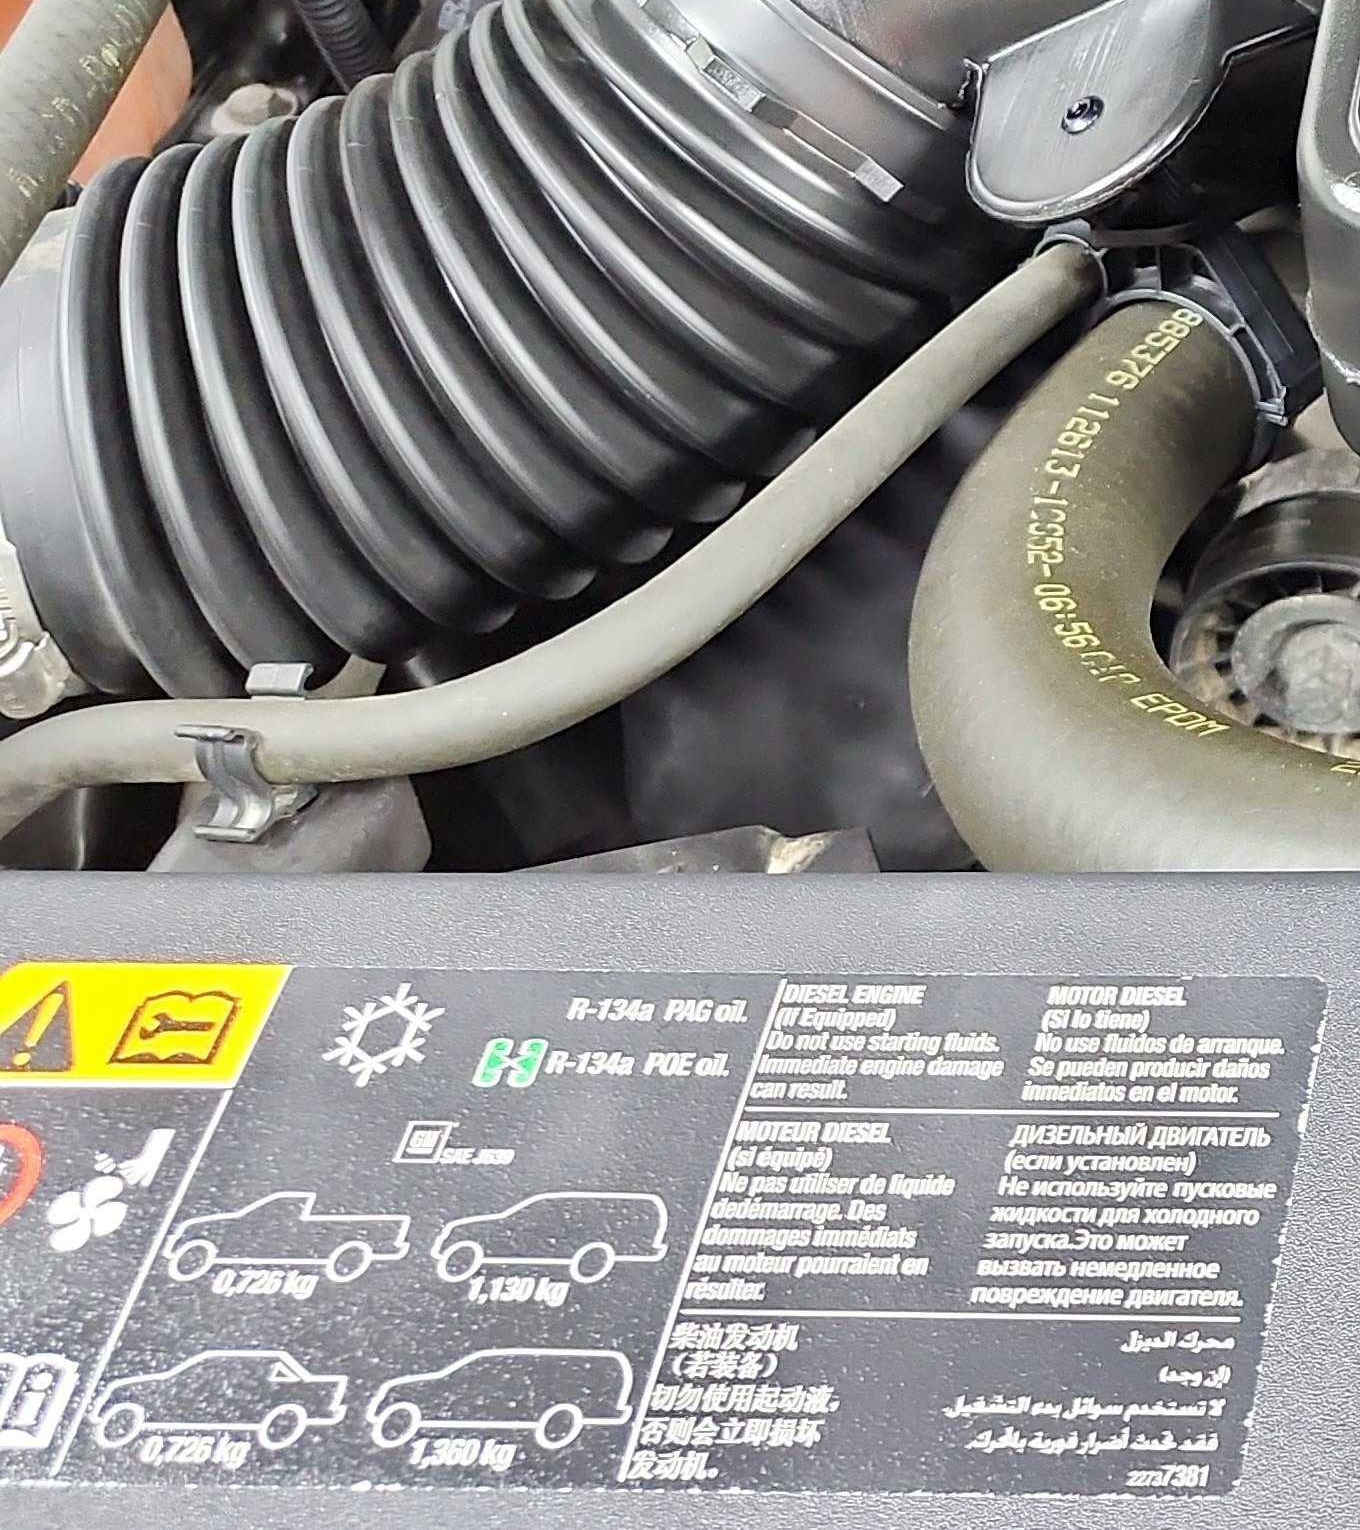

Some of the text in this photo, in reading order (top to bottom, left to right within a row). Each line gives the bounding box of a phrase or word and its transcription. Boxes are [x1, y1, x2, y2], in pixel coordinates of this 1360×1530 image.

[1129, 692, 1232, 738] EPDM
[782, 983, 927, 1005] DIESEL ENGINE
[1047, 985, 1187, 1007] MOTOR DIESEL
[566, 997, 748, 1023] R-134a PAG oil.
[773, 1006, 897, 1032] (If Equipped)
[1041, 1008, 1150, 1033] (Si lo tiene)
[765, 1030, 1000, 1056] Do not use starting fluids.
[1034, 1032, 1285, 1059] No use fluidos de arranque.
[544, 1050, 730, 1077] R-134a POE oil.
[759, 1054, 1005, 1080] Immediate engine damage
[1027, 1056, 1271, 1081] Se pueden producir daños
[750, 1078, 848, 1100] can result.
[1021, 1080, 1239, 1103] inmediatos en el motor.
[734, 1119, 893, 1145] MOTEUR DIESEL
[1009, 1122, 1271, 1150] ДИЗЕЛЬНЫЙ ДВИГАТЕЛЬ
[727, 1147, 833, 1173] (si équipé)
[1004, 1150, 1197, 1176] (если установлен)
[718, 1173, 956, 1200] Ne pas utiliser de liquide
[997, 1176, 1277, 1203] Не используйте пусковые
[989, 1206, 1260, 1228] жидкости для холодного
[702, 1225, 918, 1251] dommages immédiats
[693, 1252, 930, 1279] au moteur pourraient en
[976, 1259, 1221, 1282] вызвать немедленное
[212, 1268, 320, 1301] 0,726 kg
[468, 1275, 571, 1307] 1,130 kg
[685, 1277, 766, 1301] résulter.
[969, 1286, 1244, 1309] повреждение двигателя.
[668, 1322, 800, 1352] 柴油发动机
[640, 1417, 826, 1448] 否则会立即损坏
[140, 1432, 251, 1471] 0,726 kg
[409, 1437, 518, 1473] 1,360 kg
